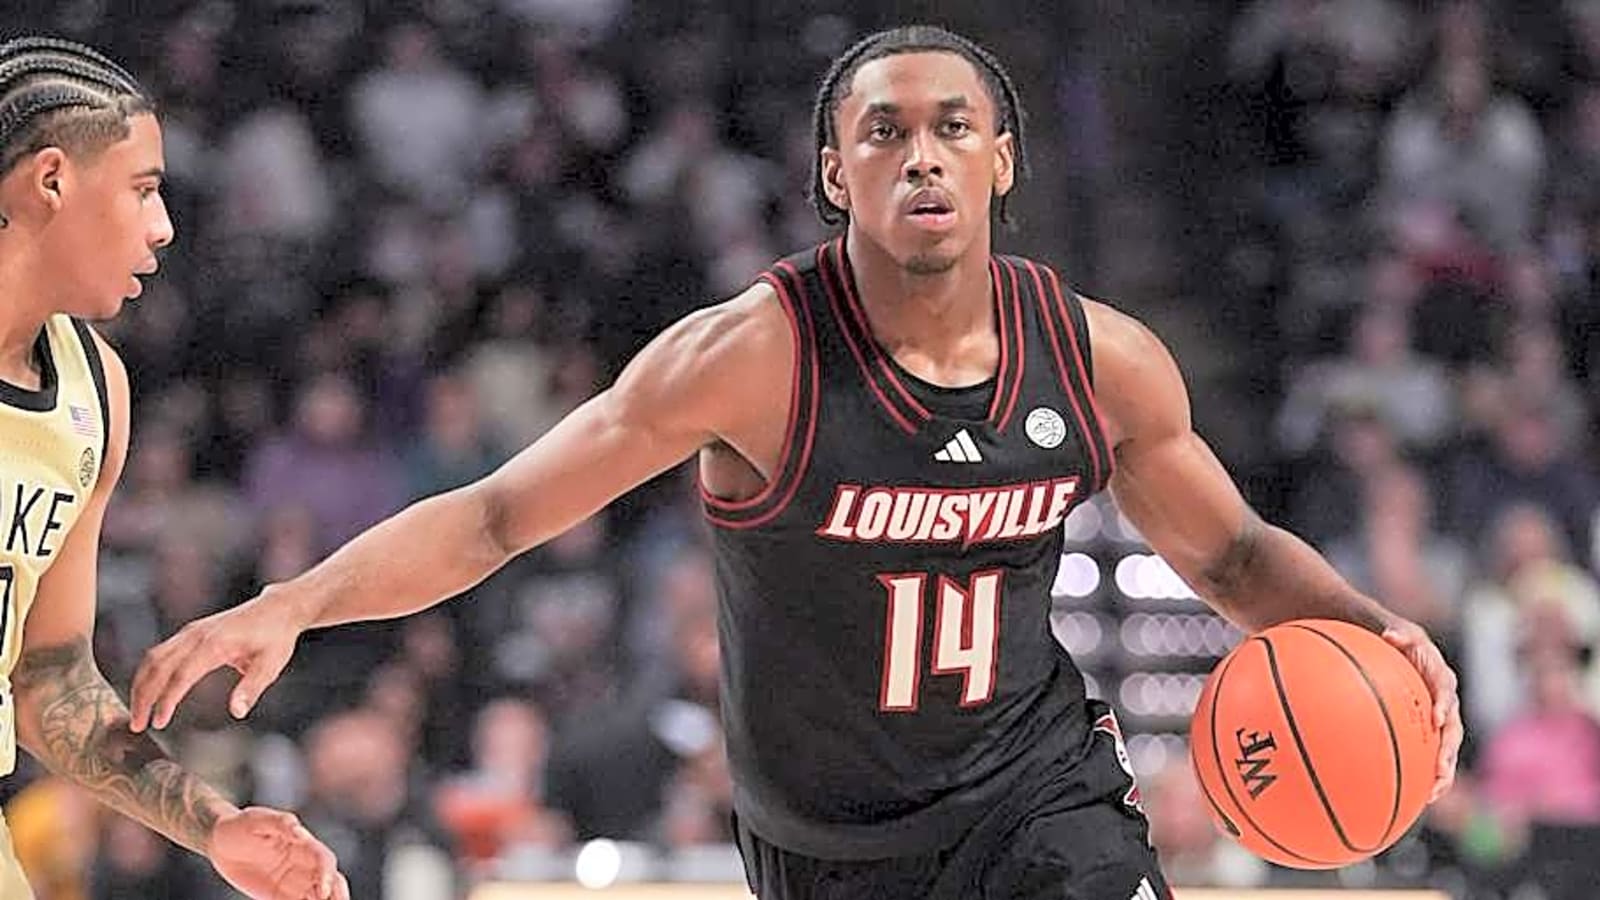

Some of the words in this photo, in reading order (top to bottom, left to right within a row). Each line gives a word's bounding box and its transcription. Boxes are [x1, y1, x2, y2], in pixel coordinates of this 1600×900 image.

[6, 483, 75, 557] KE
[815, 475, 1081, 547] LOUISVILLE
[876, 568, 1003, 712] 14
[1235, 727, 1278, 800] WF
